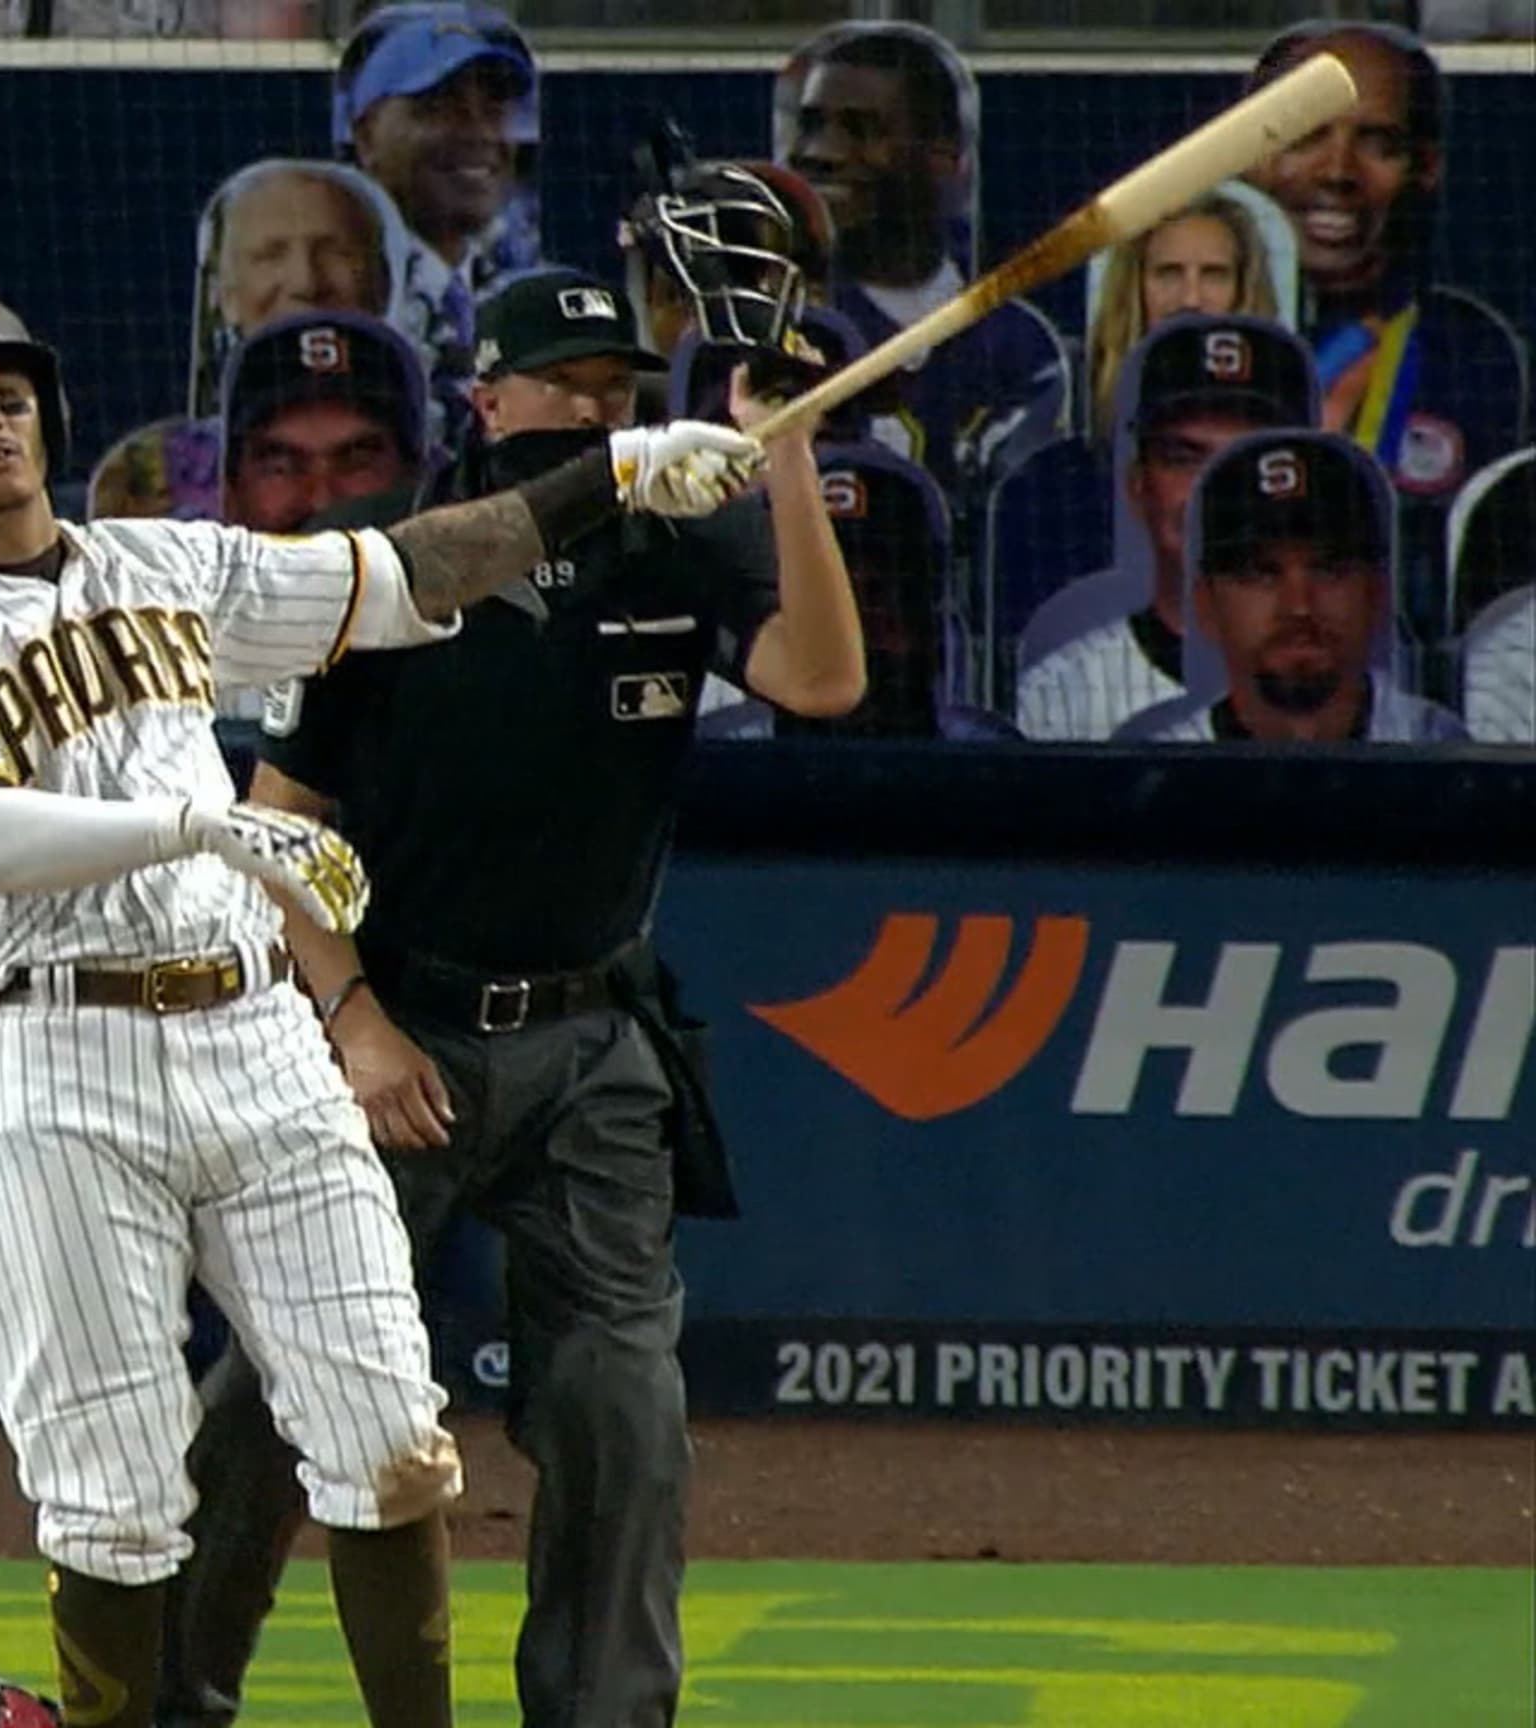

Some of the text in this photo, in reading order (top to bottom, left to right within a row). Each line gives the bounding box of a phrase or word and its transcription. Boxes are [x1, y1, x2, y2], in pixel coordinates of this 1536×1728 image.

[534, 560, 575, 588] 89
[776, 1342, 1536, 1415] 2021 PRIORITY TICKET A
